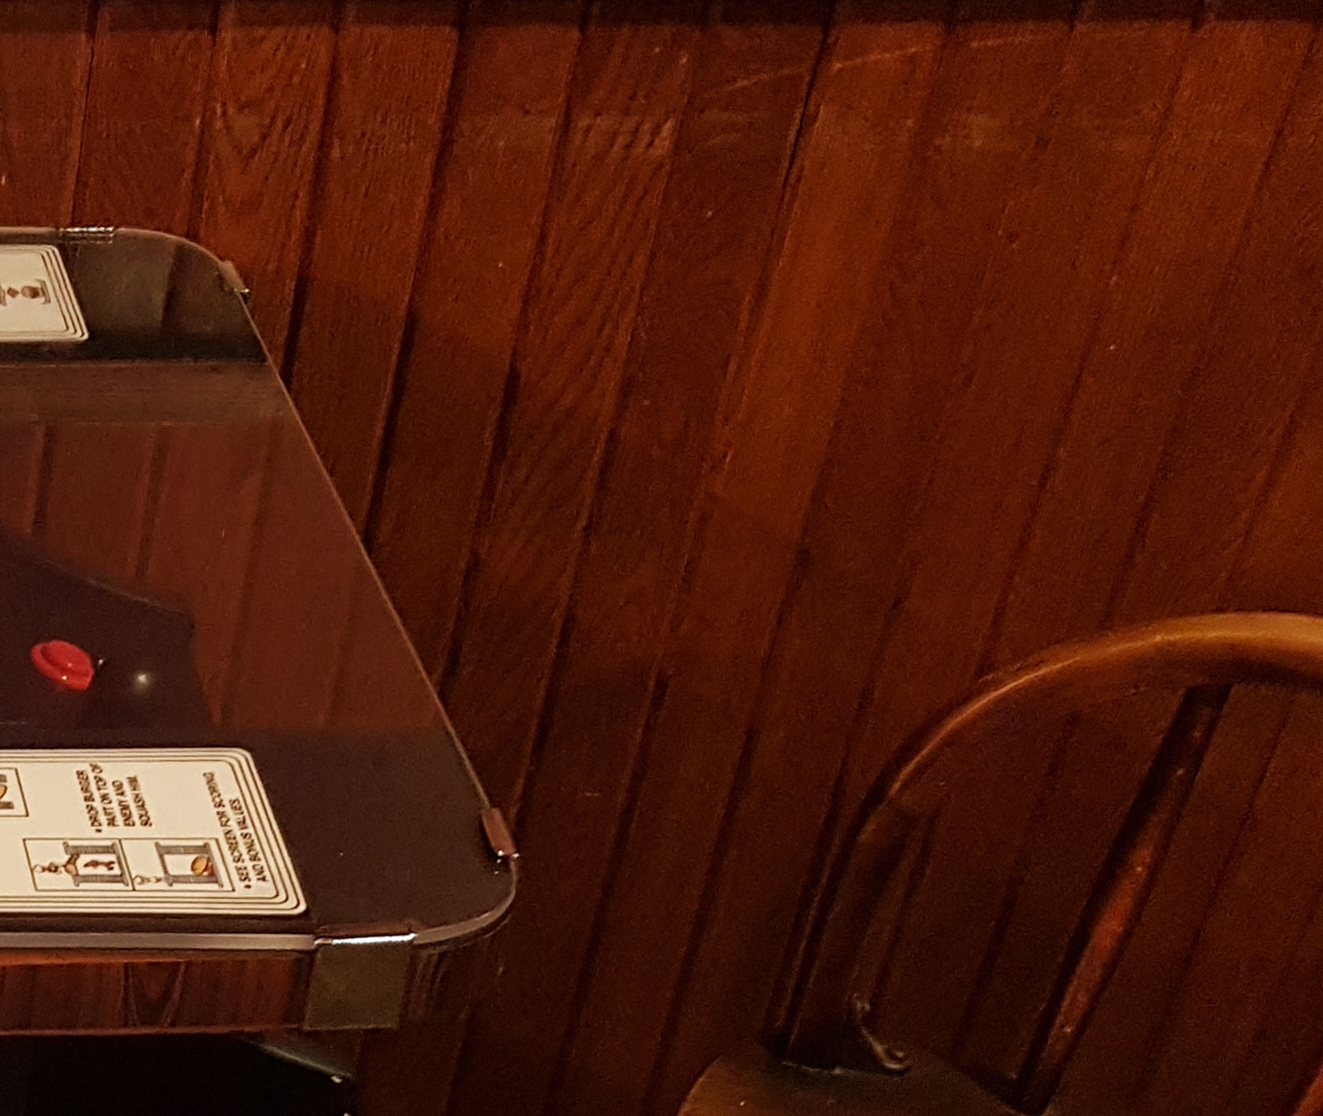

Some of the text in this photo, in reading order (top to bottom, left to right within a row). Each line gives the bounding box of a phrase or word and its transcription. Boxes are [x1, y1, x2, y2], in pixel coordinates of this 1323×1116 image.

[89, 762, 119, 826] PART ON TOP OF
[110, 779, 136, 826] ENEMY AND
[84, 804, 102, 826] DROP
[215, 810, 233, 827] FOR
[221, 829, 245, 862] SCREEN
[239, 832, 261, 861] BONUS
[233, 865, 251, 881] SEE
[249, 864, 268, 881] AND
